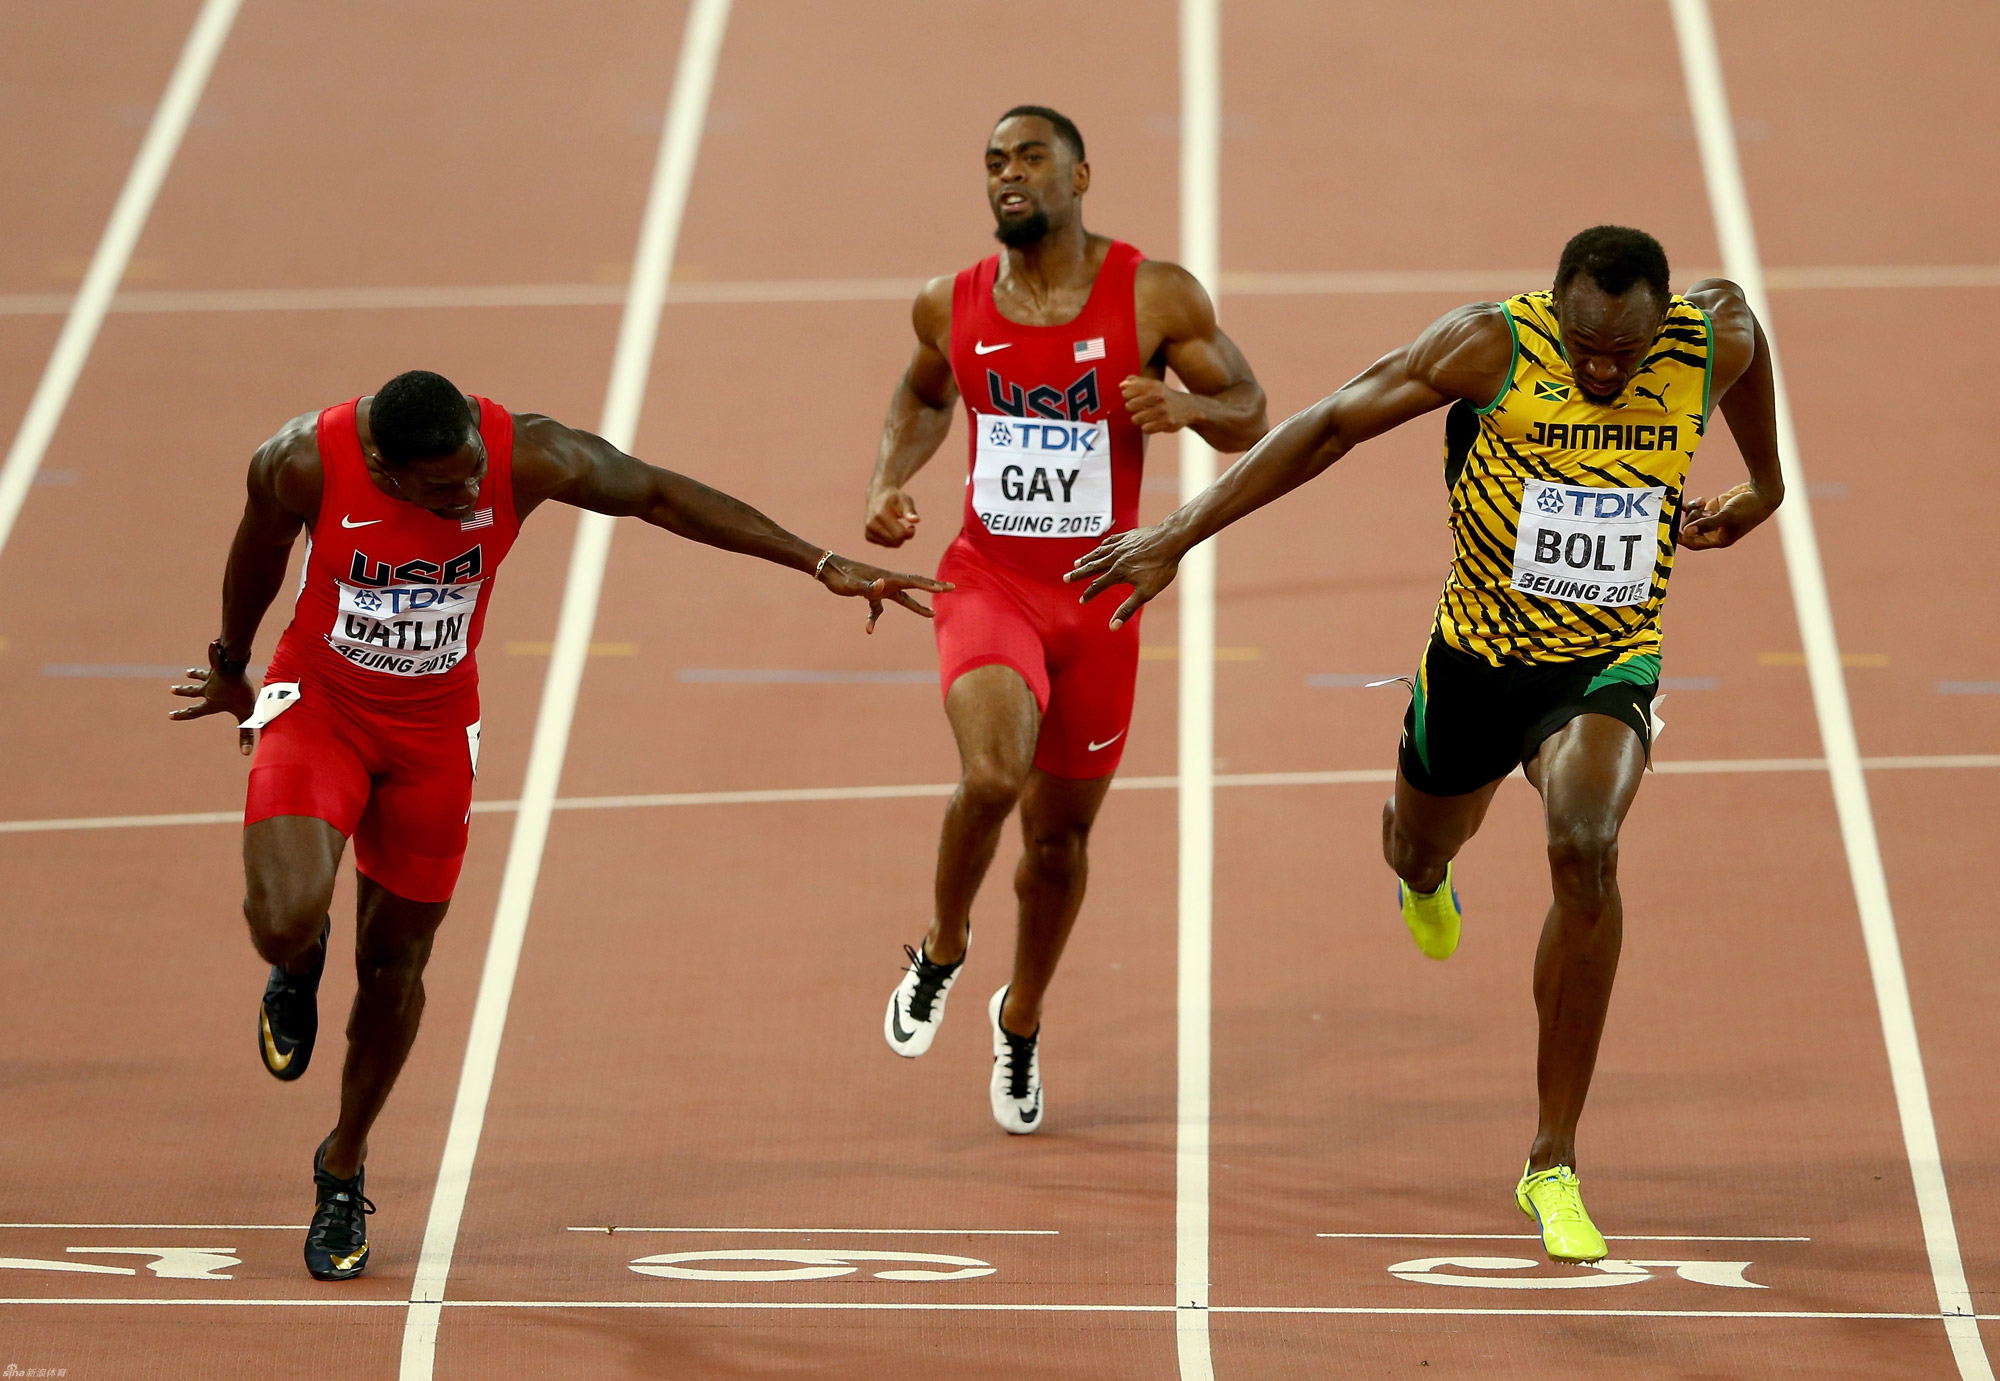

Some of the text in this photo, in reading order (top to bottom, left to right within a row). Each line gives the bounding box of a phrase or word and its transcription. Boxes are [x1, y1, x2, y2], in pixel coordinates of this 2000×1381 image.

[986, 367, 1100, 422] USA
[1012, 423, 1099, 452] TDK
[1525, 422, 1678, 451] JAMAICA
[1001, 465, 1081, 503] GAY
[1564, 490, 1654, 519] TDK
[980, 512, 1103, 534] BEIJING 2015
[349, 543, 483, 587] USA
[1534, 528, 1642, 572] BOLT
[380, 587, 465, 614] TDK
[1518, 572, 1646, 603] BEIJING 2015
[344, 613, 465, 651] GATLIN
[337, 643, 458, 675] BEIJING 2015
[628, 1249, 997, 1282] 6
[1387, 1256, 1771, 1289] 5
